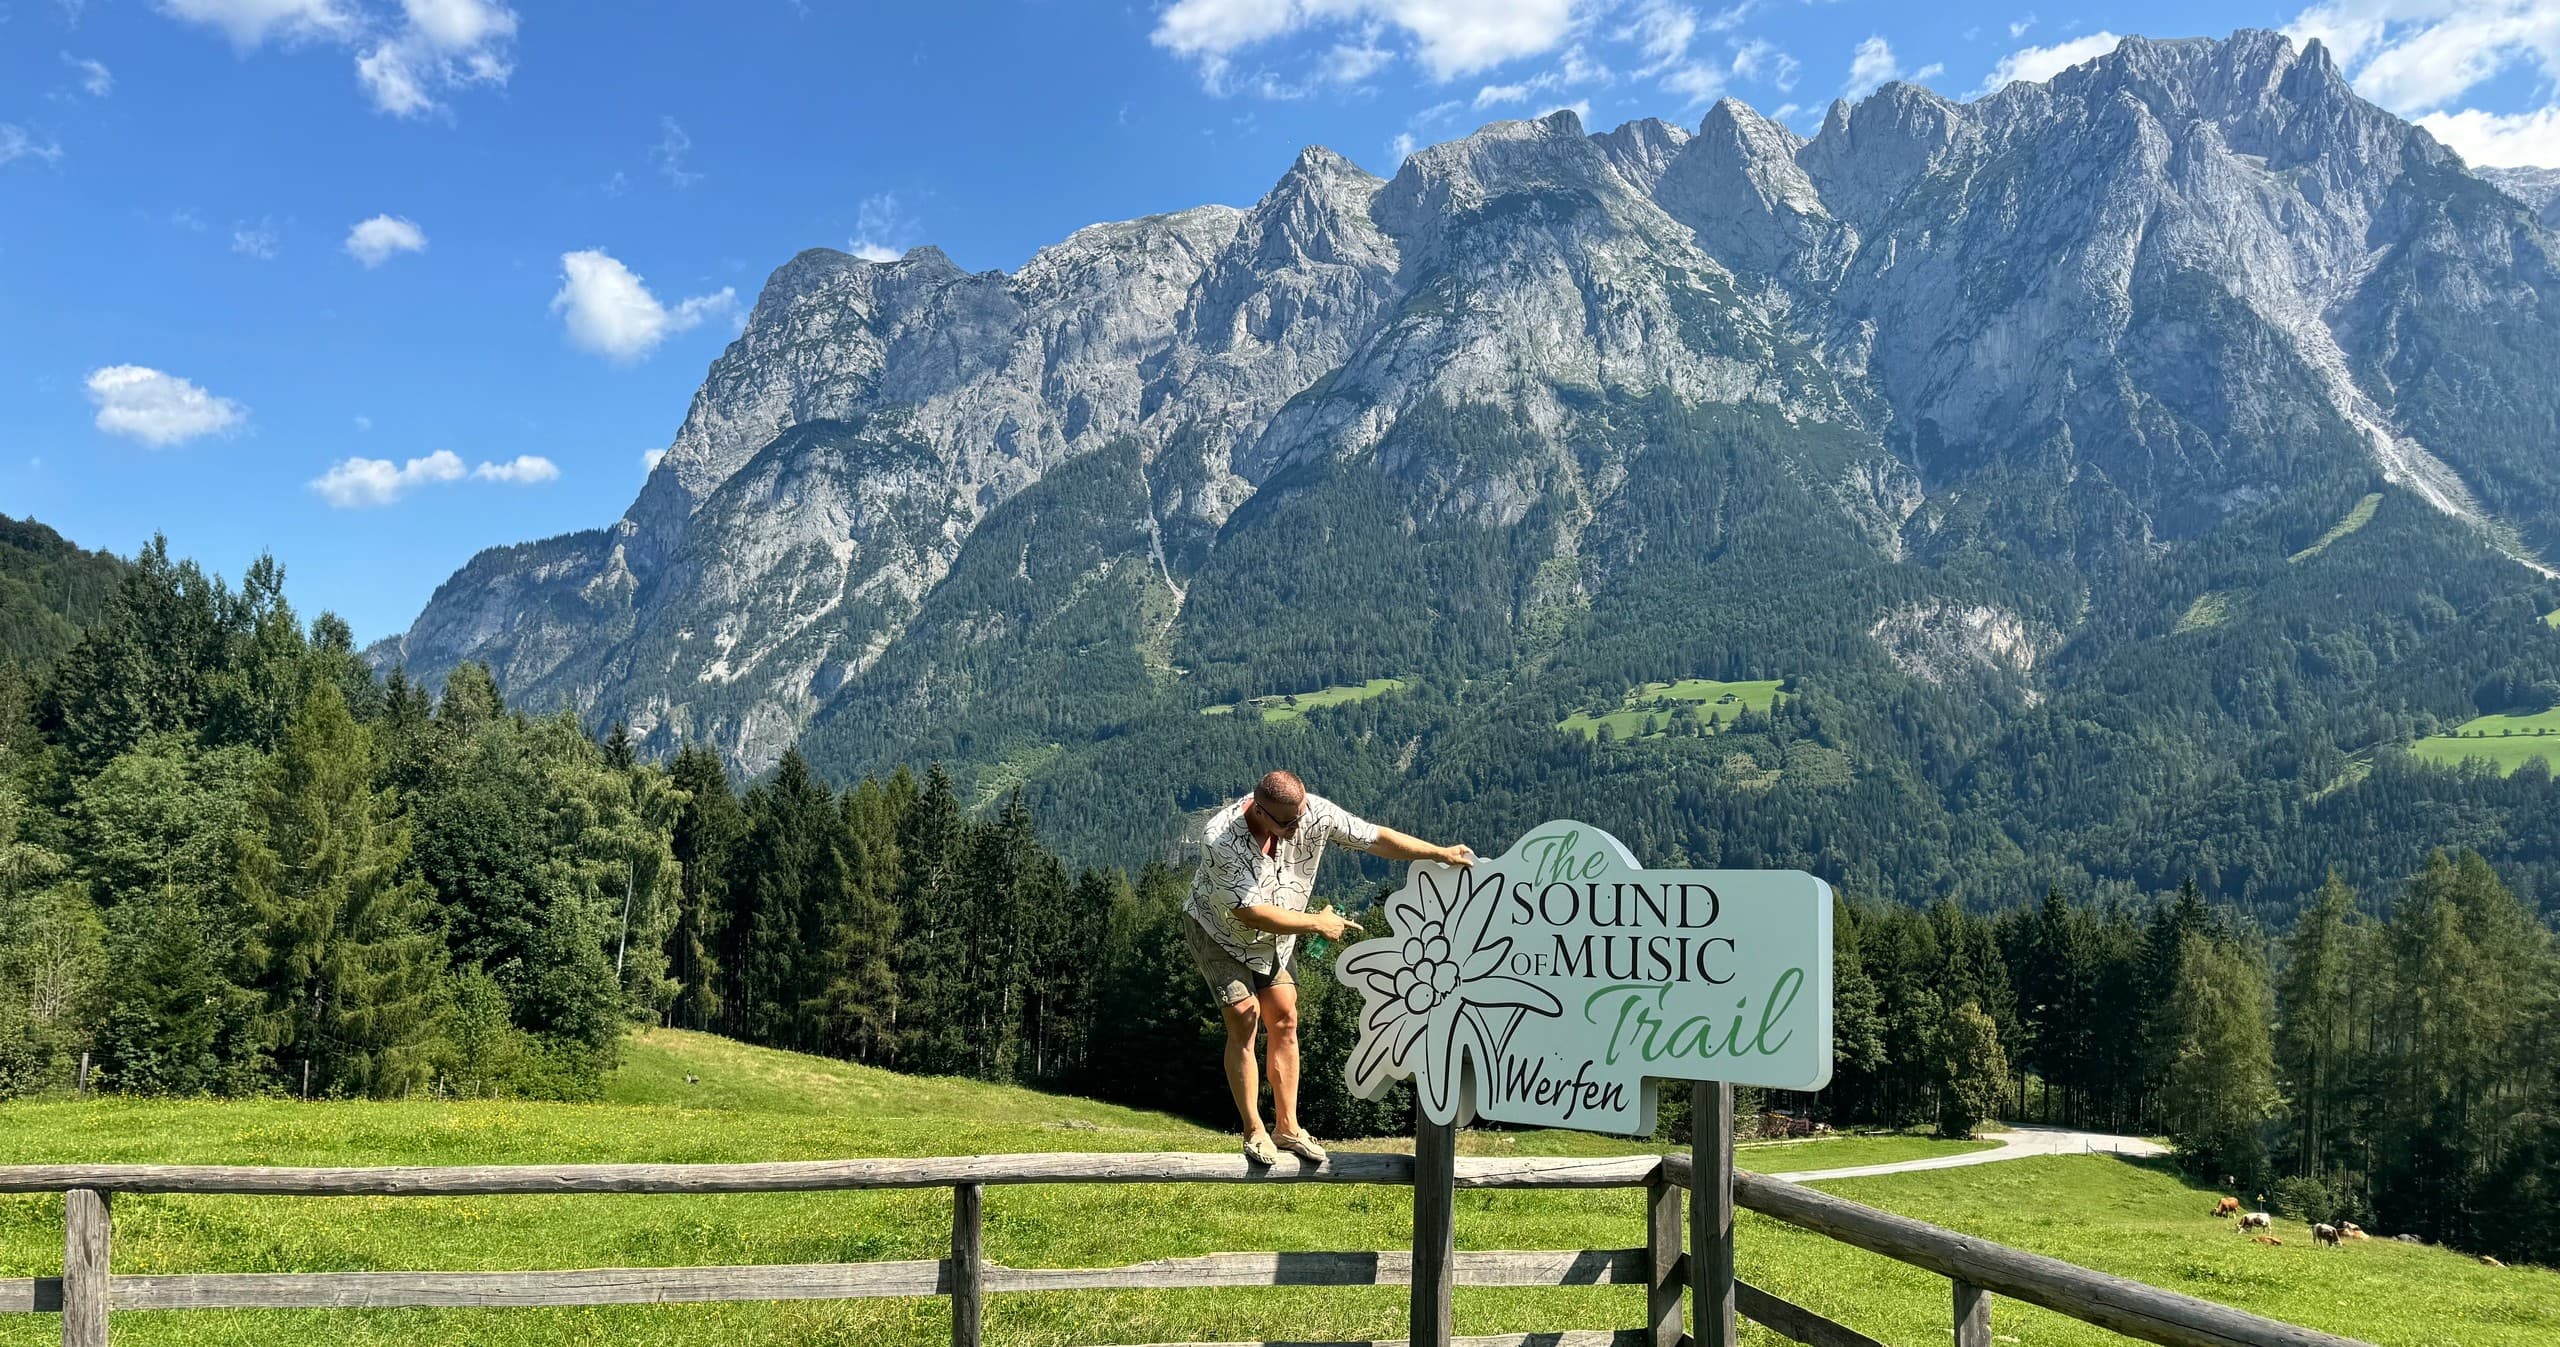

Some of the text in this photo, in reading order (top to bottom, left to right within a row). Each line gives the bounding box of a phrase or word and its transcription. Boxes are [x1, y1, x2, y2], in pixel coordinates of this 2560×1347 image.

[1521, 830, 1609, 887] The
[1511, 882, 1720, 928] SOUND
[1510, 934, 1736, 984] OF MUSIC
[1584, 967, 1804, 1065] Trail
[1505, 1054, 1629, 1120] Werfen
